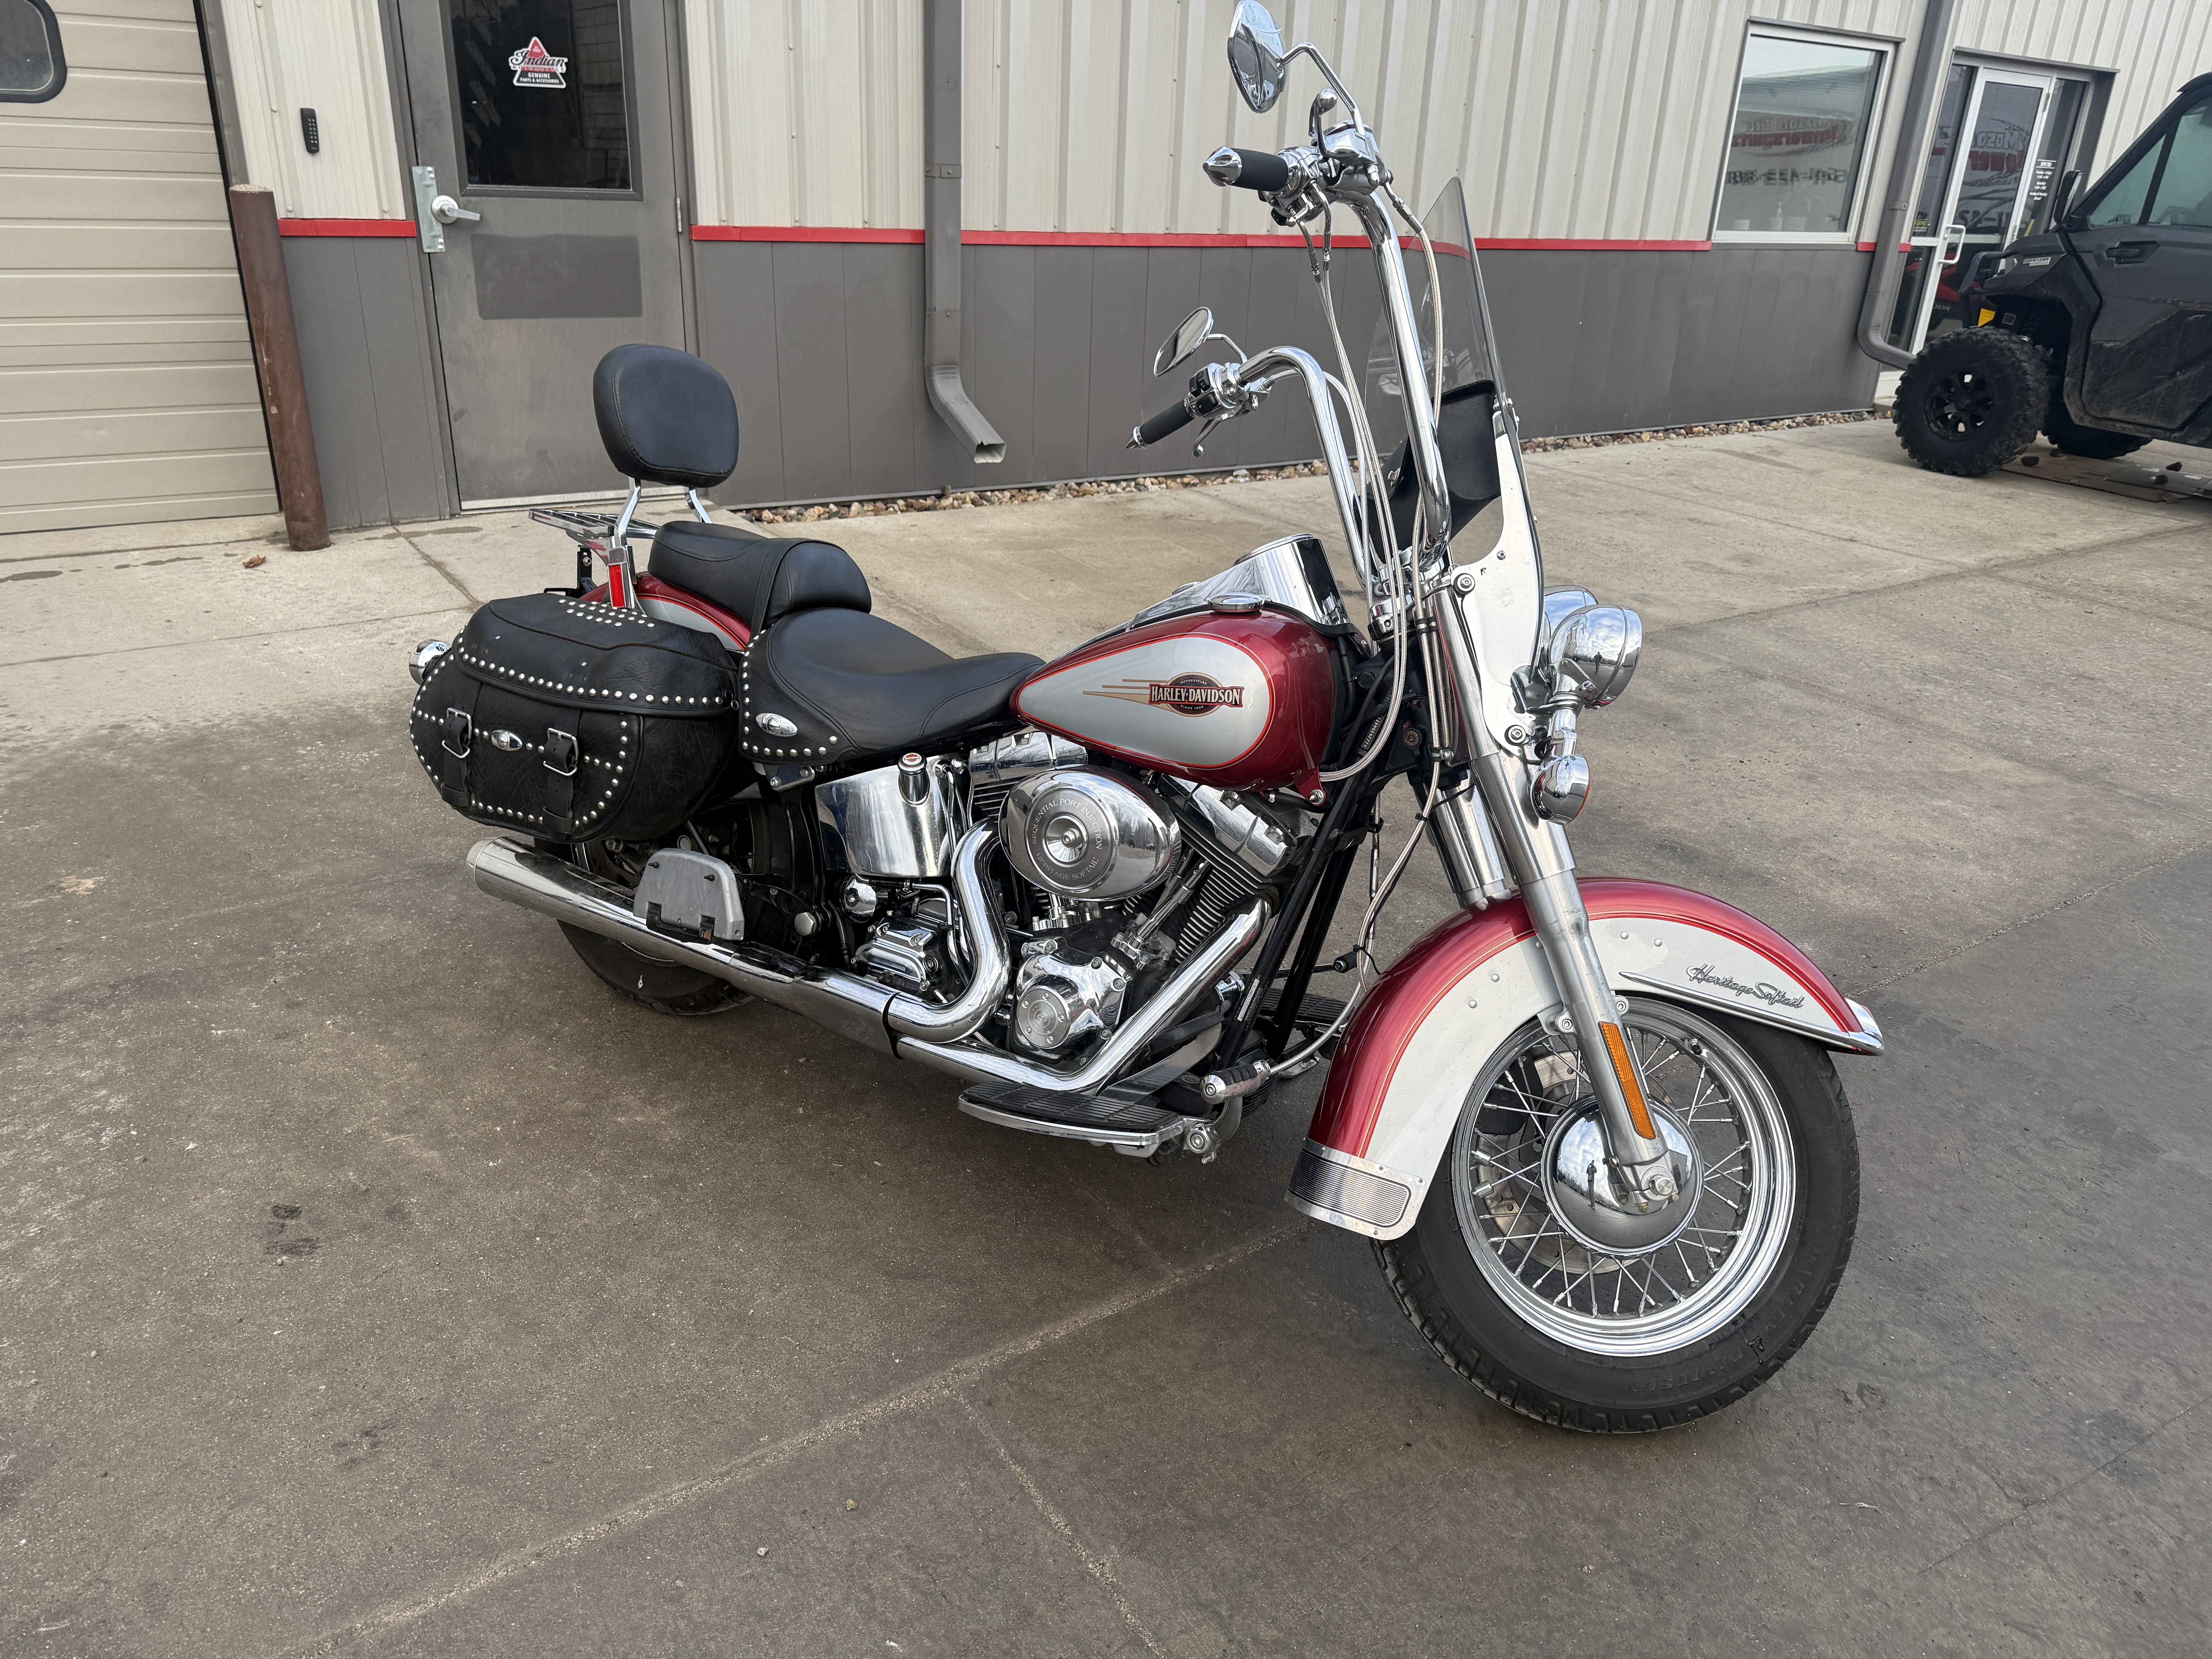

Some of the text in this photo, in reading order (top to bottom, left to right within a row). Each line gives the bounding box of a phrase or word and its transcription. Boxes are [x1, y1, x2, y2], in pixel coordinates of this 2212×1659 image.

[510, 50, 565, 67] Indian
[1032, 799, 1103, 850] SEQUENTIAL PORT INJECTION
[1036, 853, 1070, 880] HERITAGE
[1686, 963, 1805, 1009] Heritage Softail
[1626, 1345, 1743, 1392] DAVIDSON
